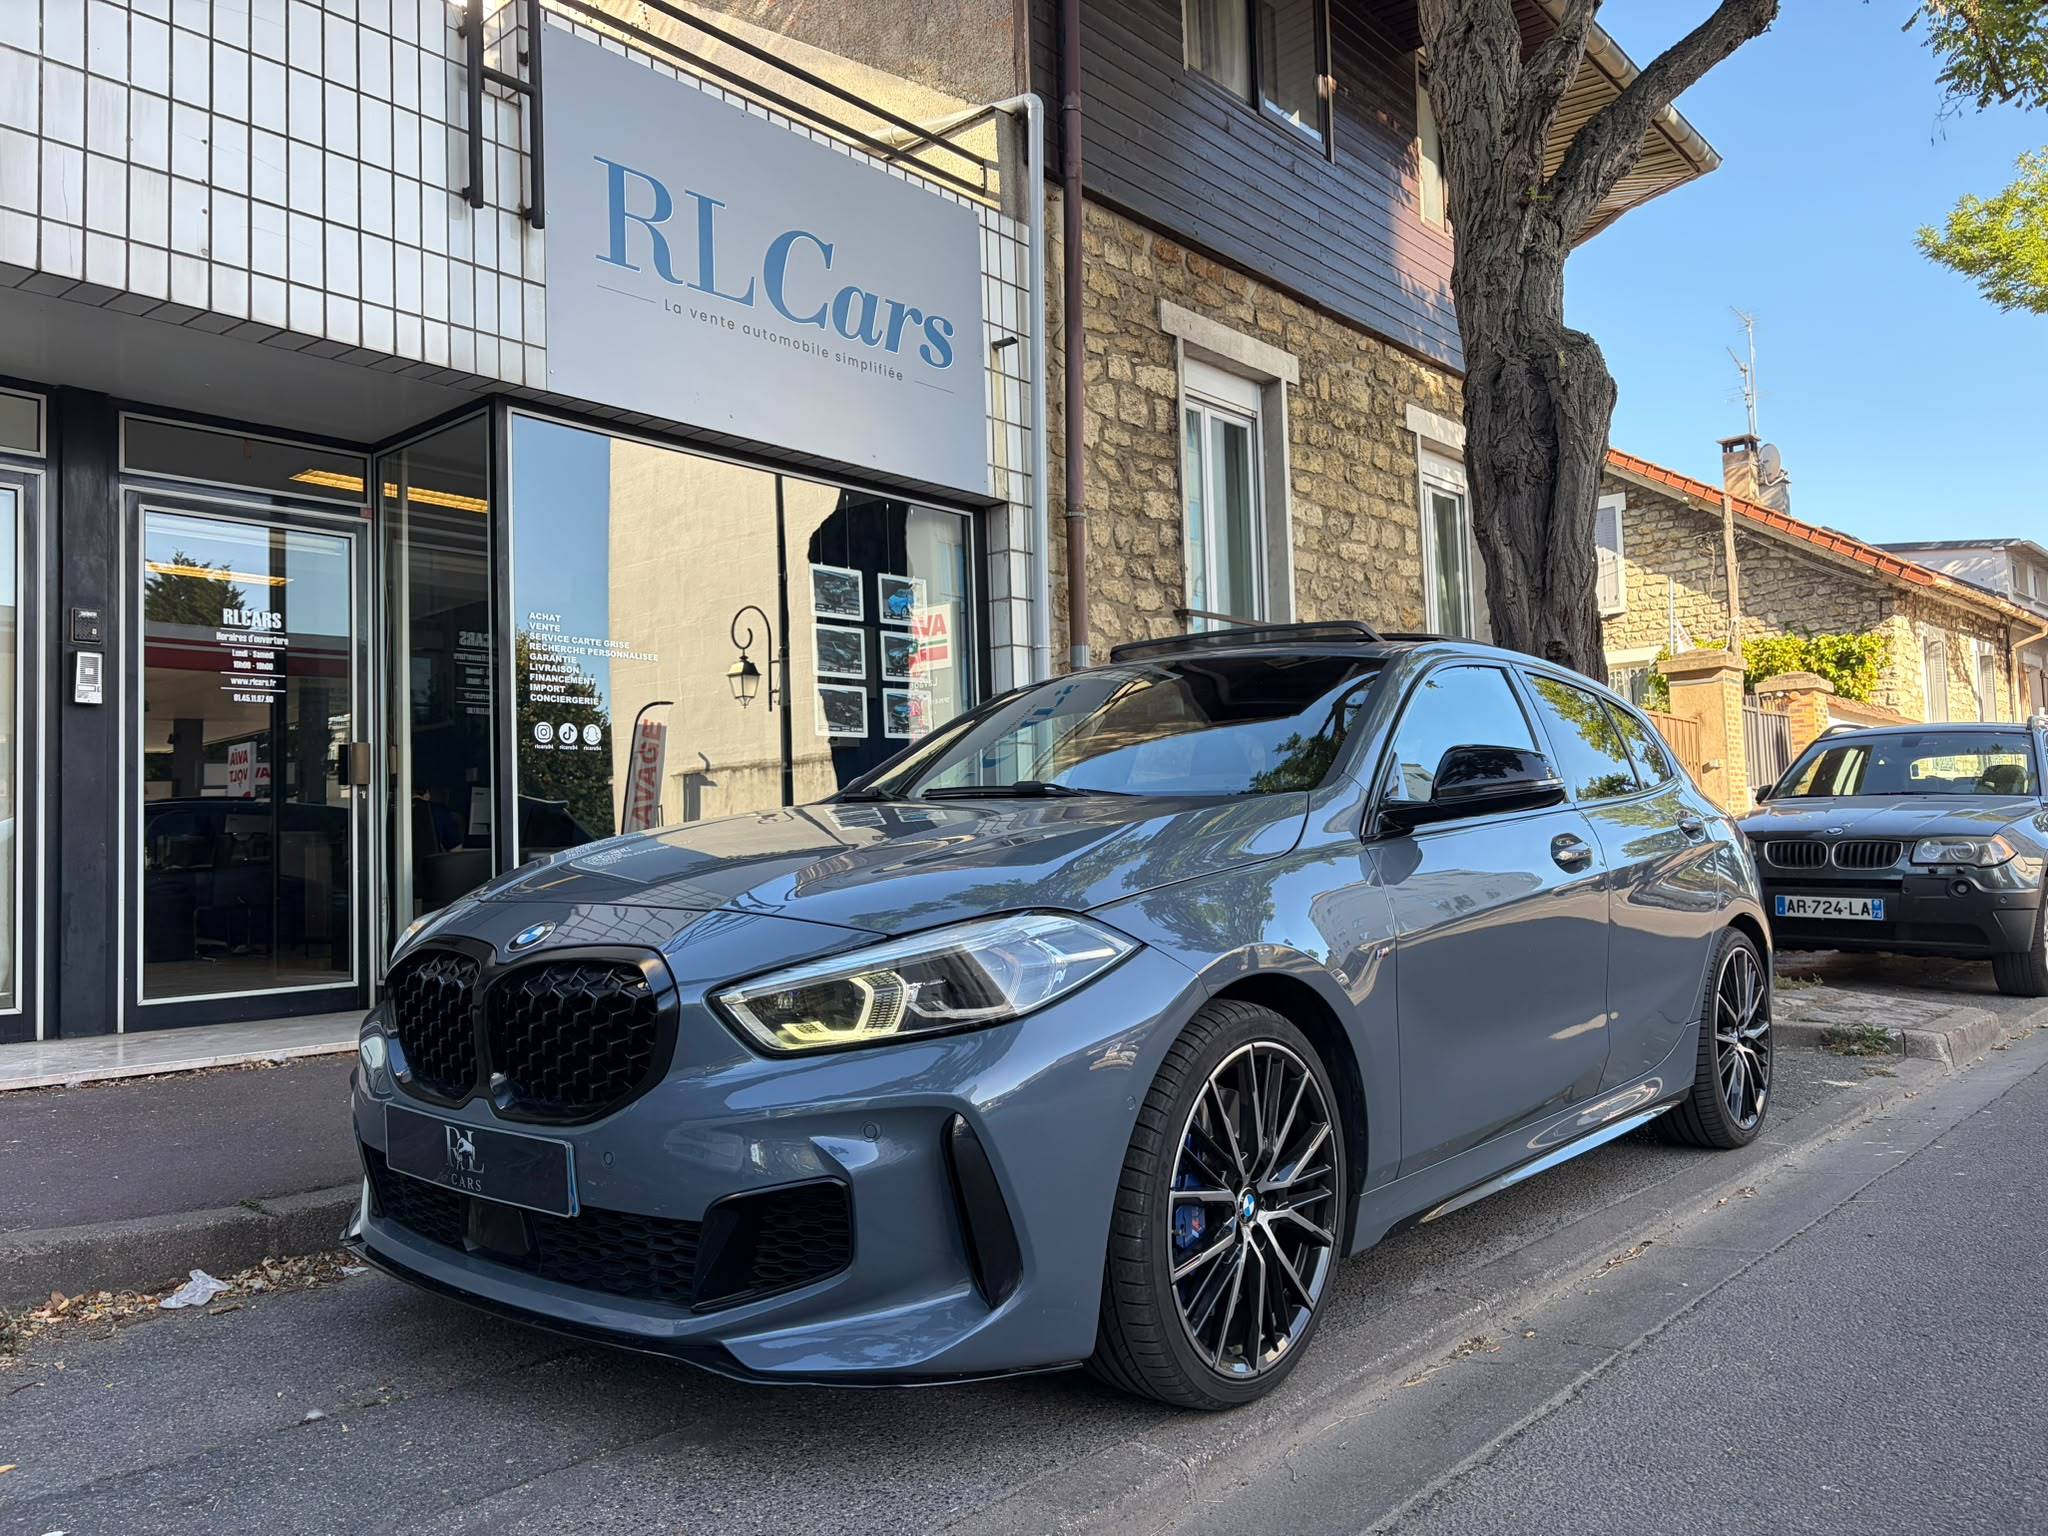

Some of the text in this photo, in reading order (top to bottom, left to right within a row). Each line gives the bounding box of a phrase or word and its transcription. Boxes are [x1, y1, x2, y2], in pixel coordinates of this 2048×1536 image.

[593, 155, 955, 369] RLCars
[664, 298, 904, 382] La vente automobile simplifiée
[222, 607, 282, 629] RLCARS
[529, 612, 561, 622] ACHAT
[529, 622, 561, 632] VENTE
[216, 631, 247, 643] Horaires
[529, 632, 631, 649] SERVICE CARTE GRISE
[529, 642, 586, 655] RECHERCHE
[529, 652, 577, 664] GARANTIE
[529, 663, 580, 674] LIVRAISON
[529, 673, 596, 685] FINANCEMENT
[529, 683, 566, 693] IMPORT
[530, 694, 600, 706] CONCIERGERIE
[632, 719, 662, 828] AVAGE
[450, 1173, 482, 1192] CARS
